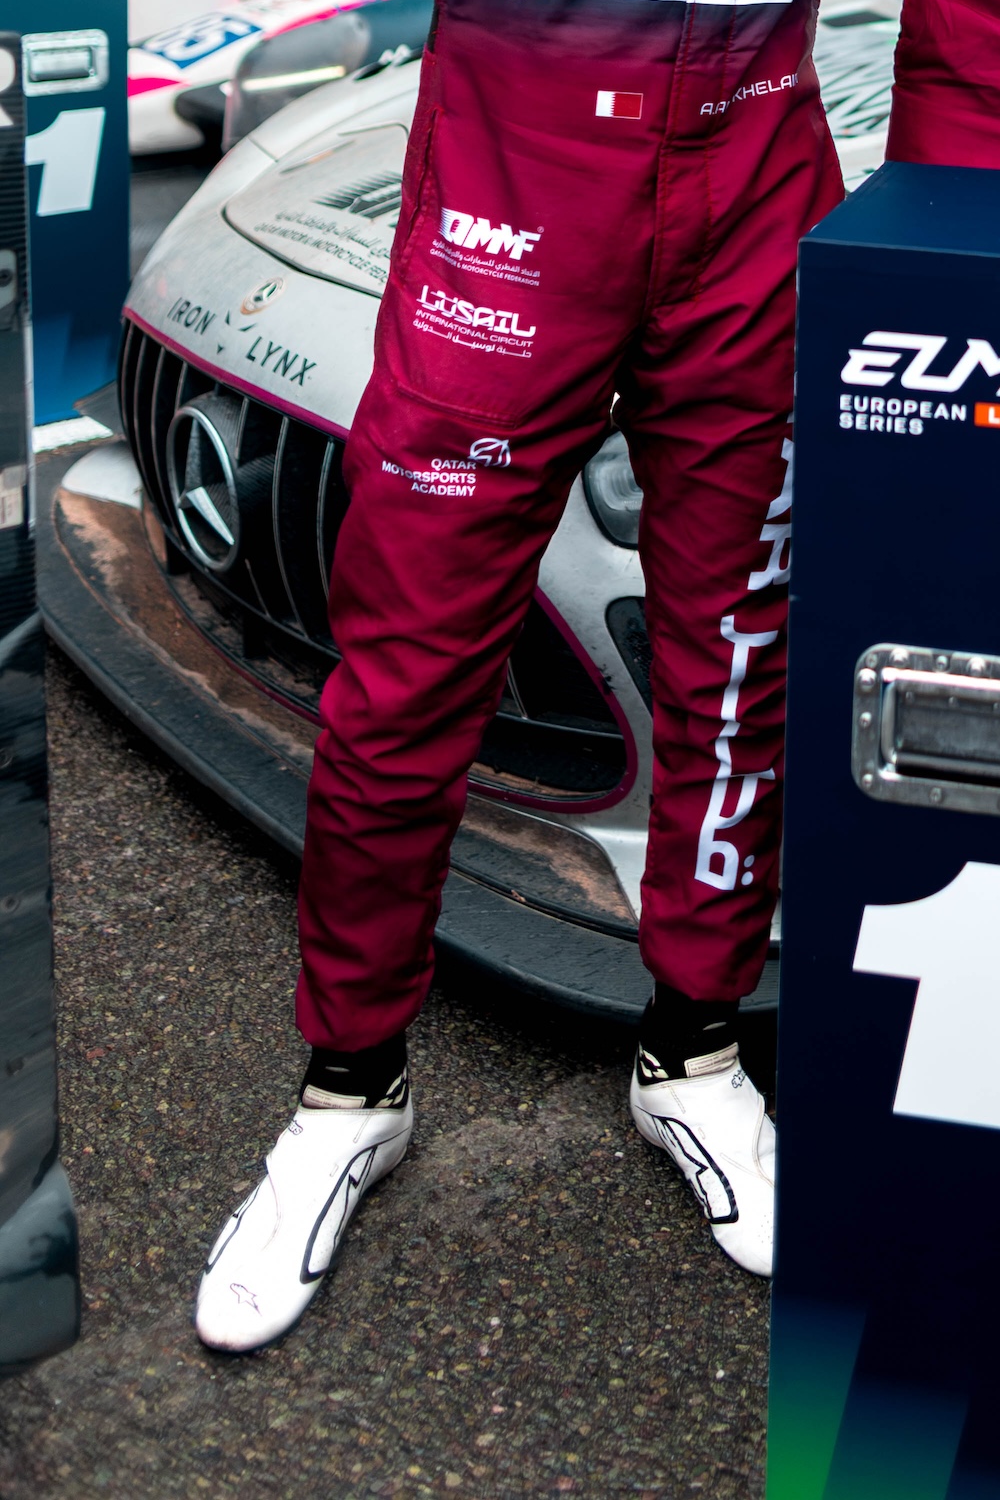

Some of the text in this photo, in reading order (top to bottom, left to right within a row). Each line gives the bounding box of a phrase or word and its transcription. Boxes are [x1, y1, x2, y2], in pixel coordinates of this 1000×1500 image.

[25, 107, 106, 217] 1
[461, 263, 503, 279] MOTORCYCLE
[415, 309, 534, 347] INTERNATIONAL CIRCUIT
[167, 297, 317, 387] IRON LYNX
[839, 394, 967, 422] EUROPEAN
[838, 412, 924, 435] SERIES
[382, 461, 476, 484] MOTORSPORTS
[431, 458, 476, 470] QATAR
[411, 481, 476, 497] ACADEMY
